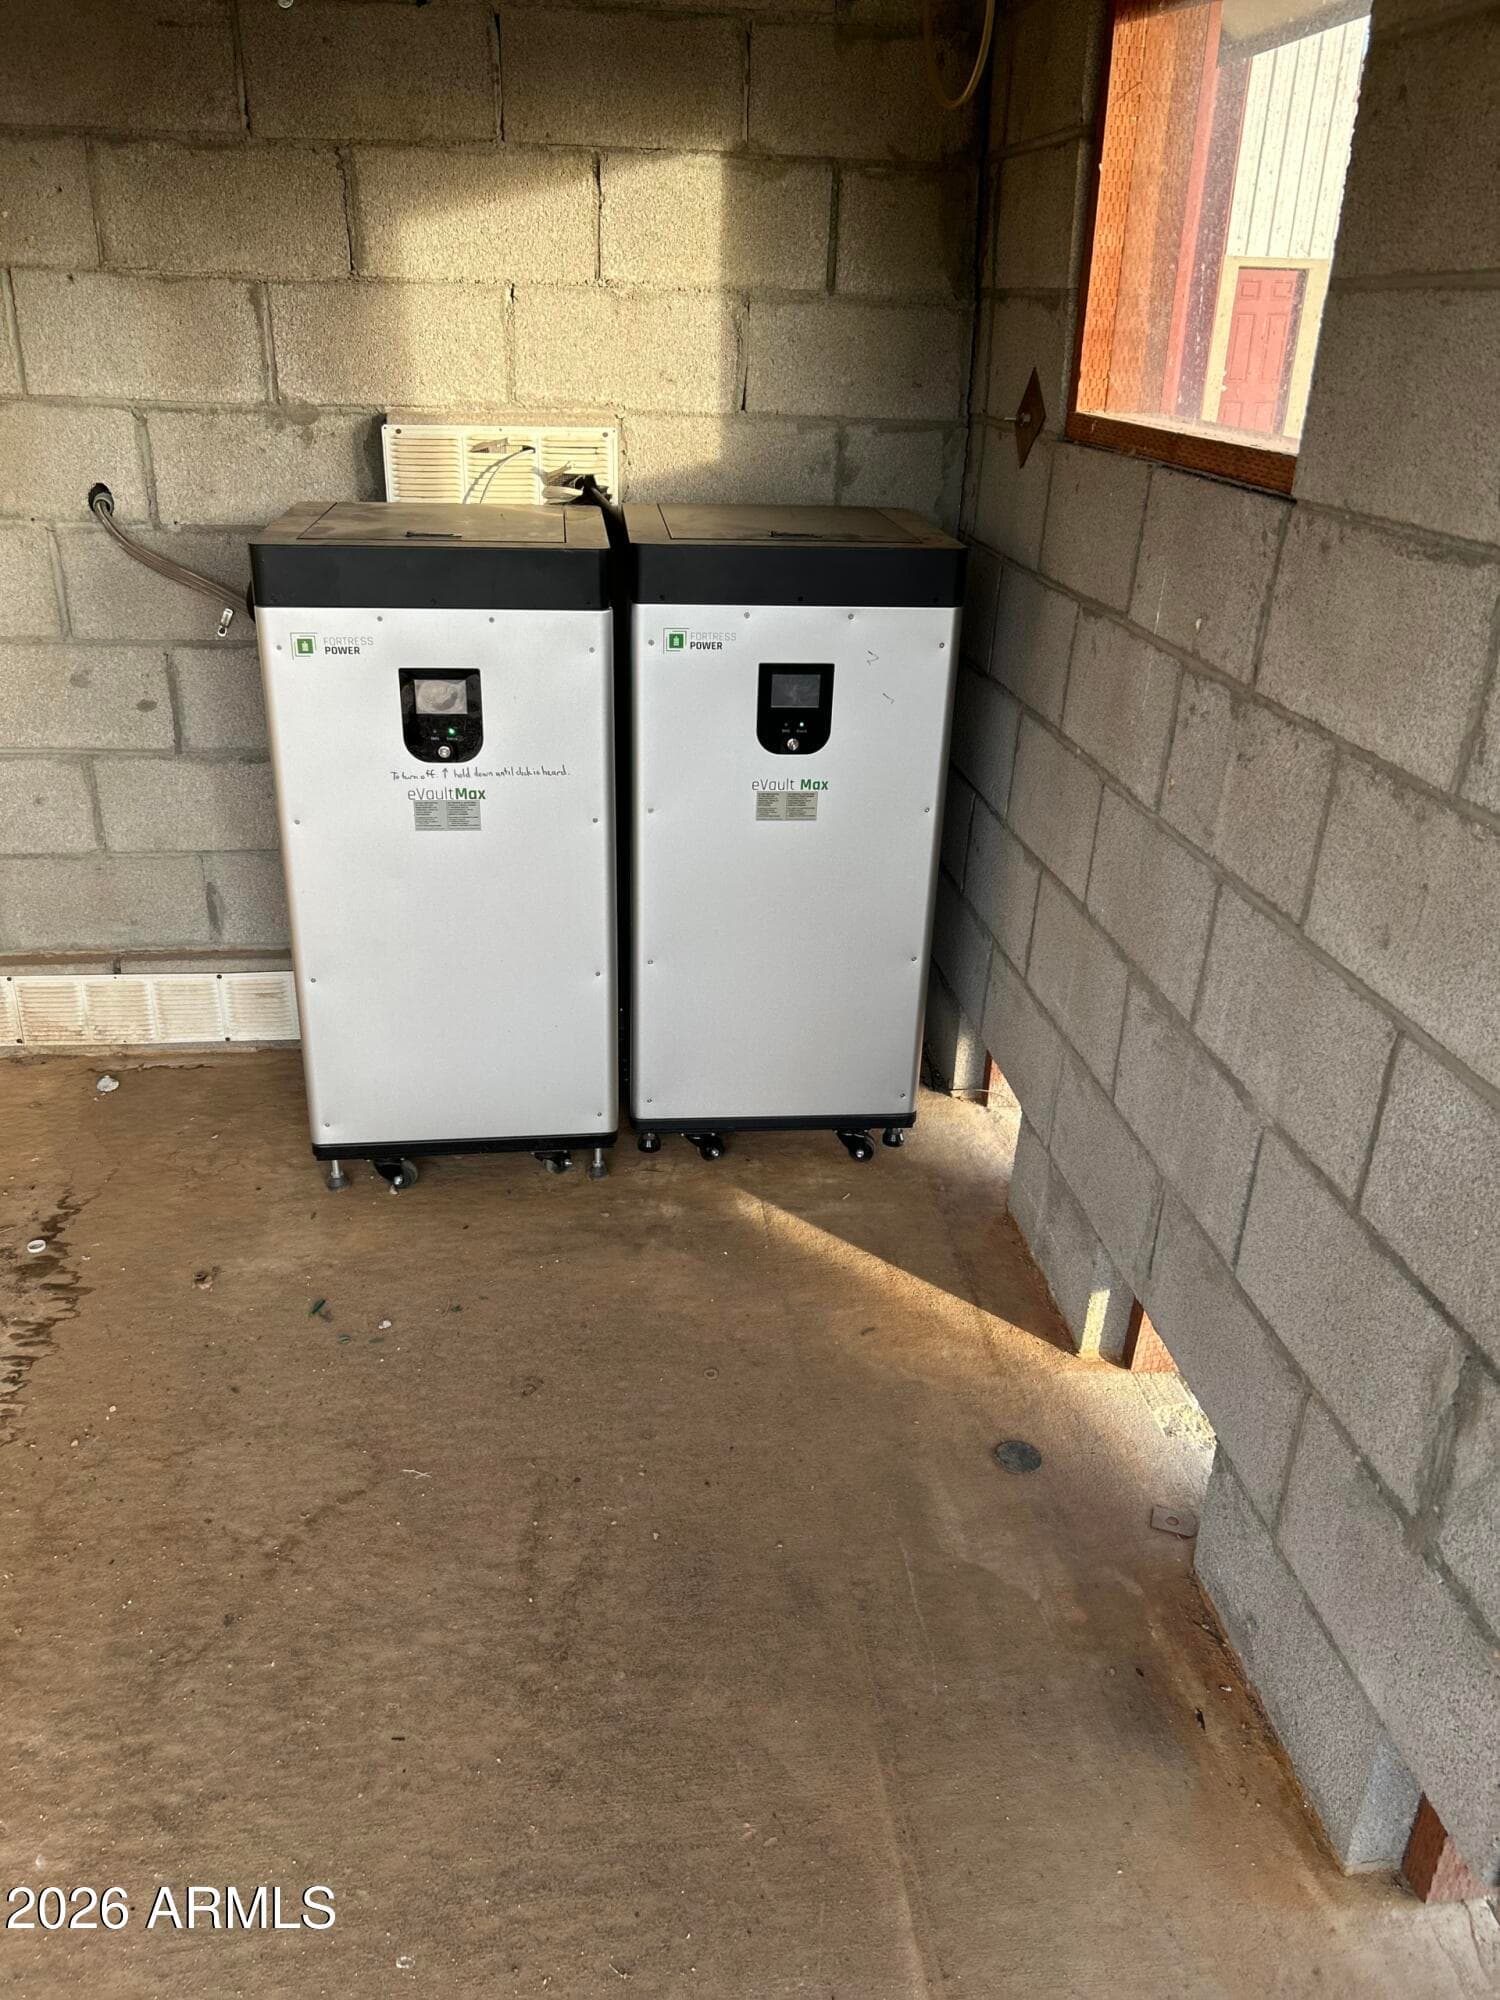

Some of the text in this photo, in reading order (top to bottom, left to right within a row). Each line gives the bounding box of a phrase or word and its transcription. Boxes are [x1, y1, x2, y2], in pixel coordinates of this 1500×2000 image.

[323, 636, 374, 646] FORTRESS
[690, 632, 737, 641] FORTRESS
[690, 641, 723, 650] POWER
[324, 646, 361, 655] POWER
[453, 767, 471, 779] hold
[474, 766, 494, 777] down
[495, 766, 514, 777] until
[751, 778, 829, 791] eVault Max
